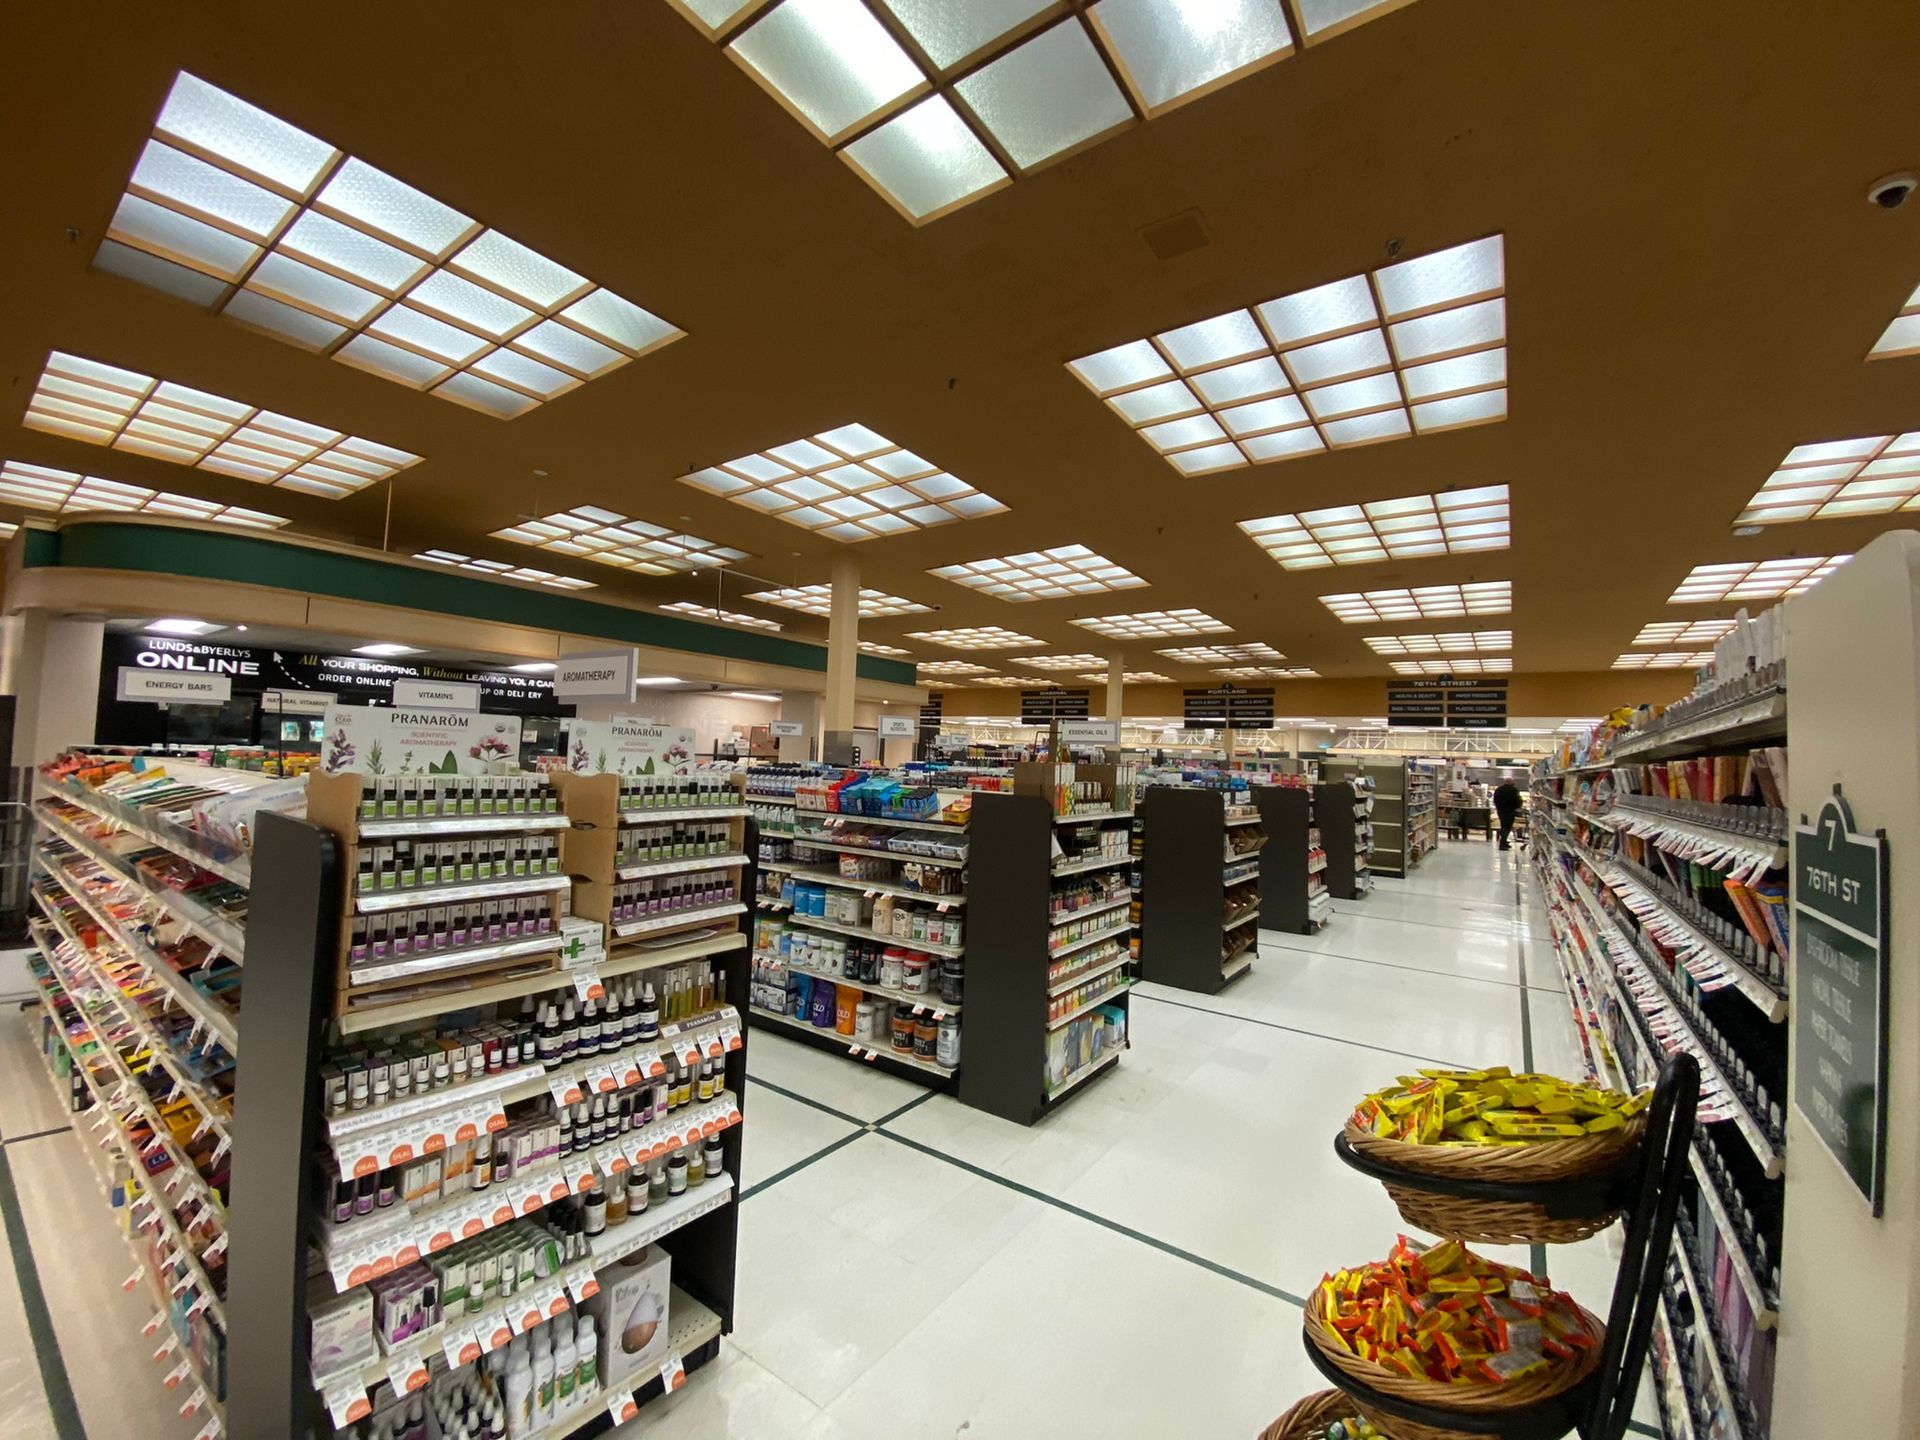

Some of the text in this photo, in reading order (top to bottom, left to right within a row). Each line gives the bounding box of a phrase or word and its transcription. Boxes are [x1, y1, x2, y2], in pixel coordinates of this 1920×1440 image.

[136, 651, 260, 676] ONLINE
[299, 655, 318, 666] All
[321, 659, 355, 670] YOUR
[359, 663, 420, 677] SHOPPING,
[423, 665, 463, 680] Without
[466, 673, 507, 684] LEAVING
[562, 670, 615, 682] AROMATHERAPY
[146, 681, 213, 691] ENERGY BARS
[318, 673, 352, 683] ORDER
[507, 691, 543, 699] DELIERY
[418, 691, 454, 700] VITAMINS
[411, 730, 448, 739] SCIENTIFIC
[400, 739, 457, 747] AROMATHERAPY
[1824, 819, 1837, 851] 7
[1806, 865, 1861, 905] 76TH ST
[489, 1119, 506, 1129] DEAL
[458, 1129, 475, 1139] DEAL
[426, 1140, 443, 1150] DEAL
[392, 1151, 411, 1161] DEAL
[357, 1161, 376, 1172] DEAL
